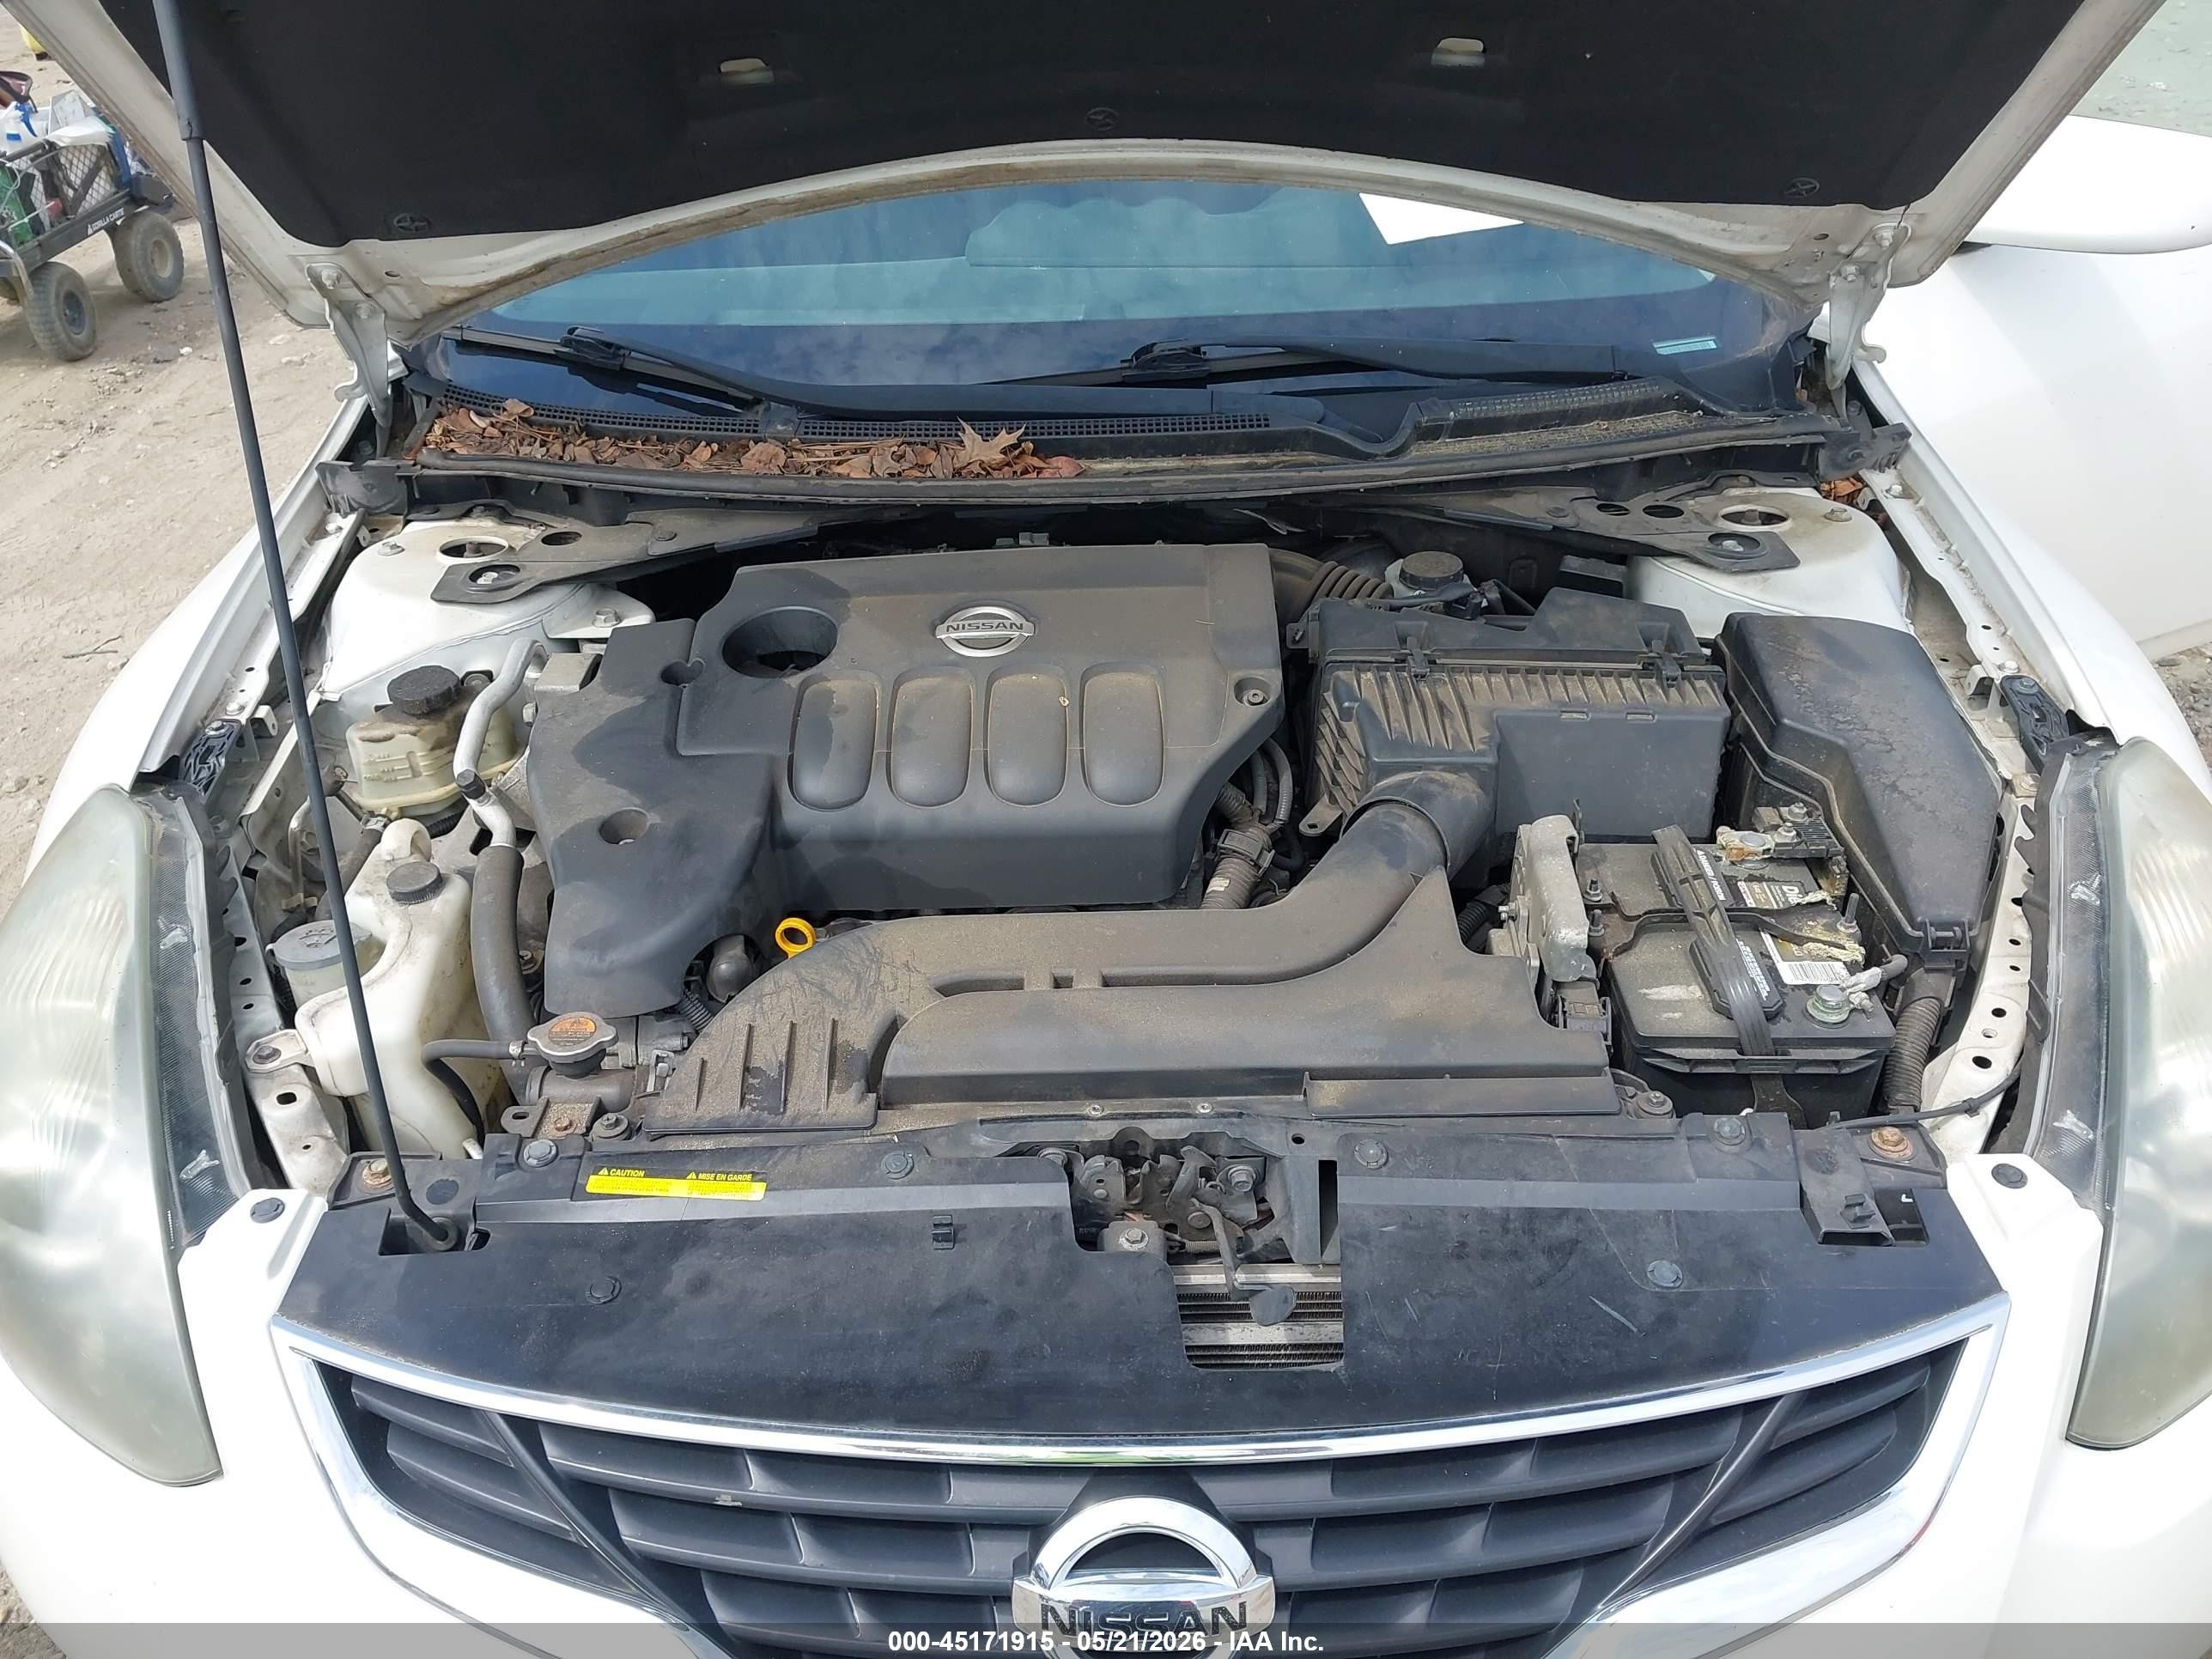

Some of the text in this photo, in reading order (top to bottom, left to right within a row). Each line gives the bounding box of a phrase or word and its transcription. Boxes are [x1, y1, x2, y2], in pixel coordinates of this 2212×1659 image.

[946, 622, 1024, 632] NISSAN
[1698, 855, 1715, 876] DANGER
[1711, 881, 1727, 901] POISON
[610, 1169, 645, 1177] CAUTION
[1041, 1600, 1247, 1638] NISSAN
